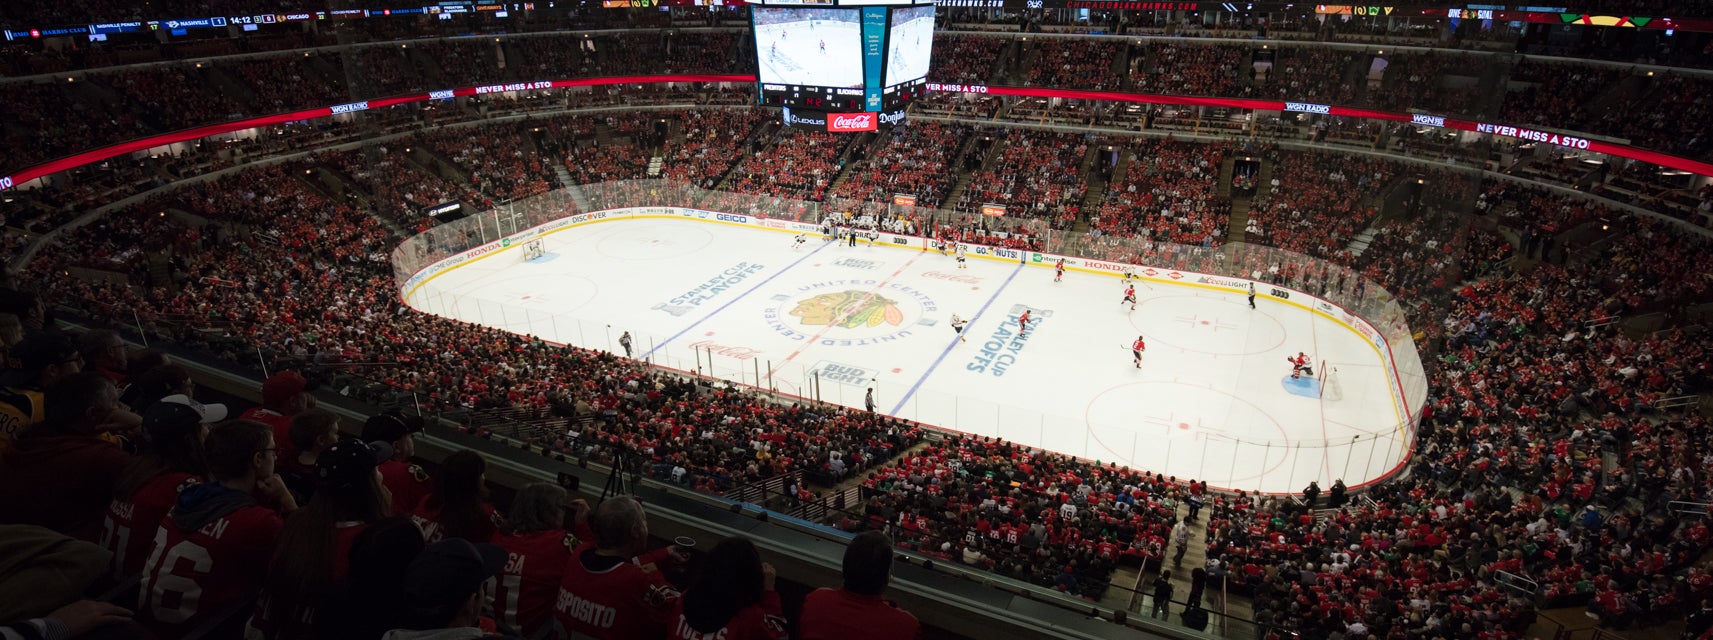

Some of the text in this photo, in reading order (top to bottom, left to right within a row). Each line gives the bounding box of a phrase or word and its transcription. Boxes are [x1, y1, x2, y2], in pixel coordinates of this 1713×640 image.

[1067, 1, 1197, 11] CHICAGOBLACKHAWKS.COM
[475, 86, 504, 94] NEVER
[505, 84, 526, 92] MISS
[942, 84, 961, 92] MISS
[963, 85, 969, 93] A
[331, 102, 368, 114] WGN RADIO
[1286, 102, 1330, 113] WGN RADIO
[797, 117, 825, 125] LEXUS
[833, 115, 872, 130] Coca-Cola
[1477, 122, 1518, 137] NEVER
[1519, 129, 1549, 143] MISS
[1550, 135, 1559, 144] A
[0, 176, 12, 190] TO
[716, 213, 747, 224] GEICO
[466, 242, 502, 259] HONDA
[996, 249, 1018, 259] NUTS!
[669, 261, 748, 306] STANLEY CUP
[687, 263, 765, 306] PLAYOFFS
[1228, 281, 1248, 289] LIGHT
[798, 279, 938, 312] UNITED CENTER
[966, 314, 1019, 374] PLAYOFFS
[824, 363, 865, 377] BUD
[990, 353, 1016, 377] CUP
[1062, 510, 1073, 521] 19
[137, 524, 214, 624] 16
